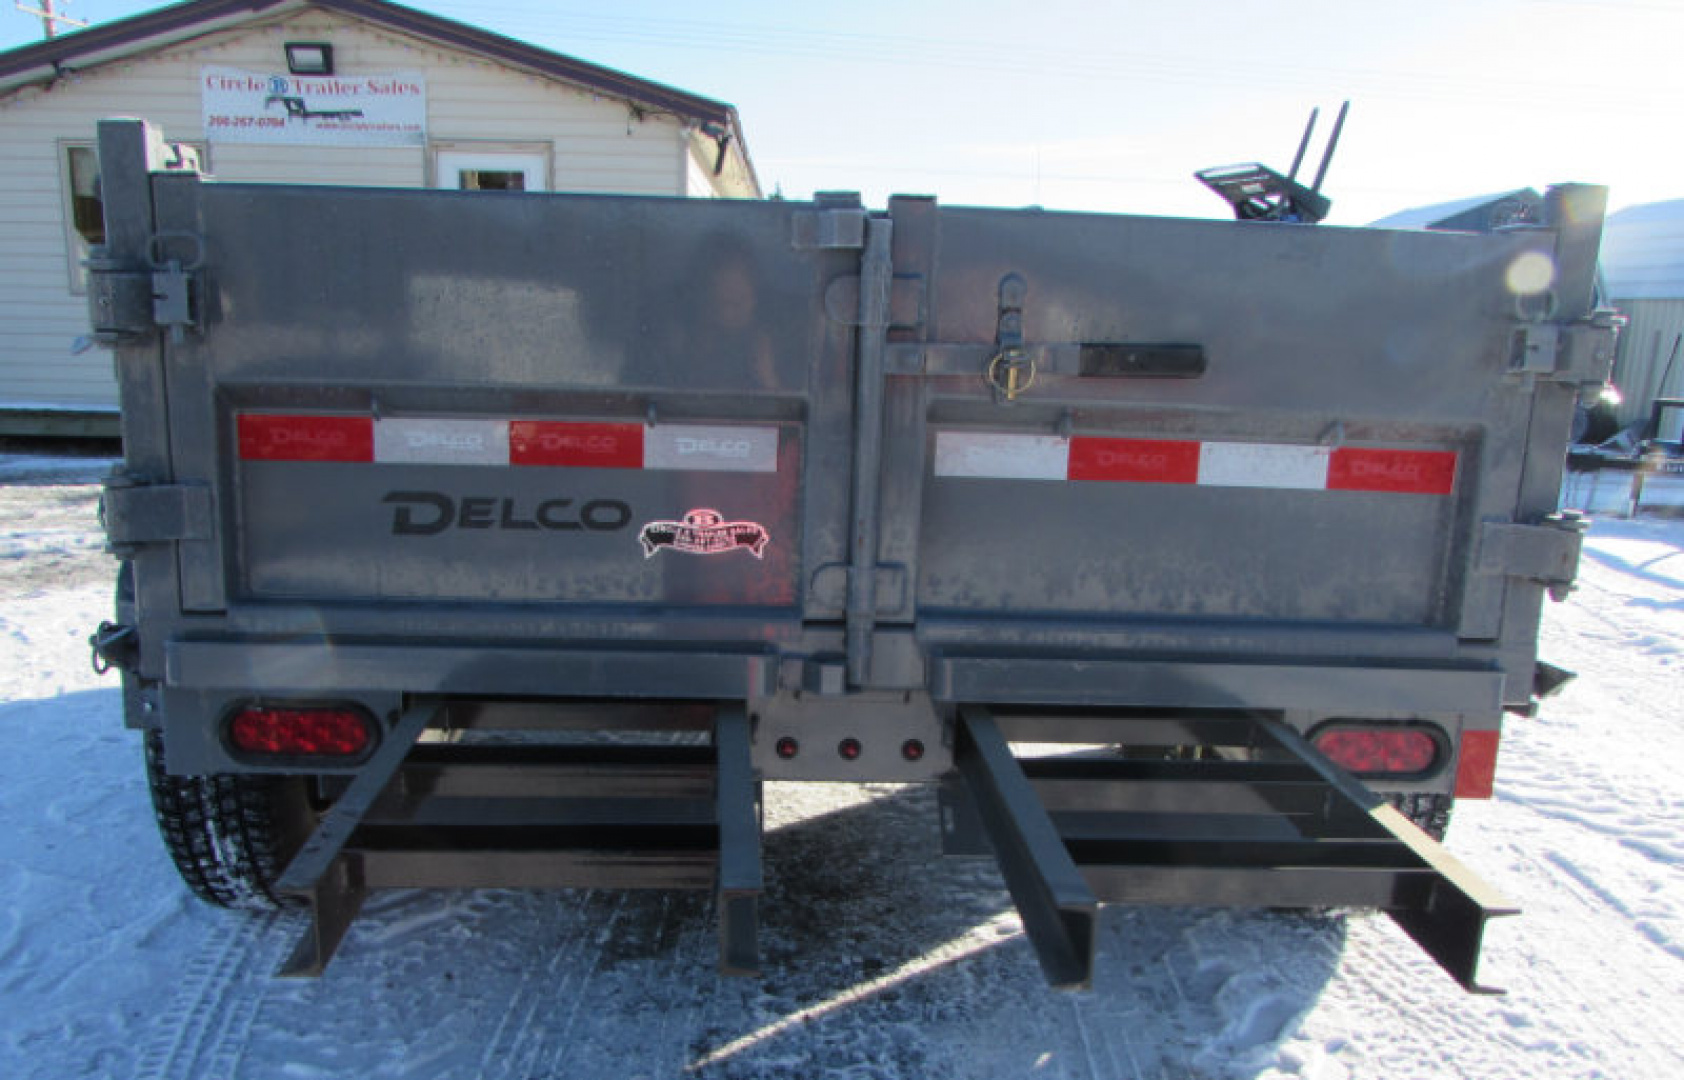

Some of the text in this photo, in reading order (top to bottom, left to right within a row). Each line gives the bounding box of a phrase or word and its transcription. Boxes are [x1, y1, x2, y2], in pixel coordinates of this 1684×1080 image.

[206, 75, 265, 92] Circle
[290, 79, 360, 95] Trailer
[367, 80, 421, 95] Sales
[269, 428, 348, 447] DELCO
[538, 434, 618, 452] DELCO
[674, 437, 752, 458] DELCO
[382, 490, 632, 536] DELCO
